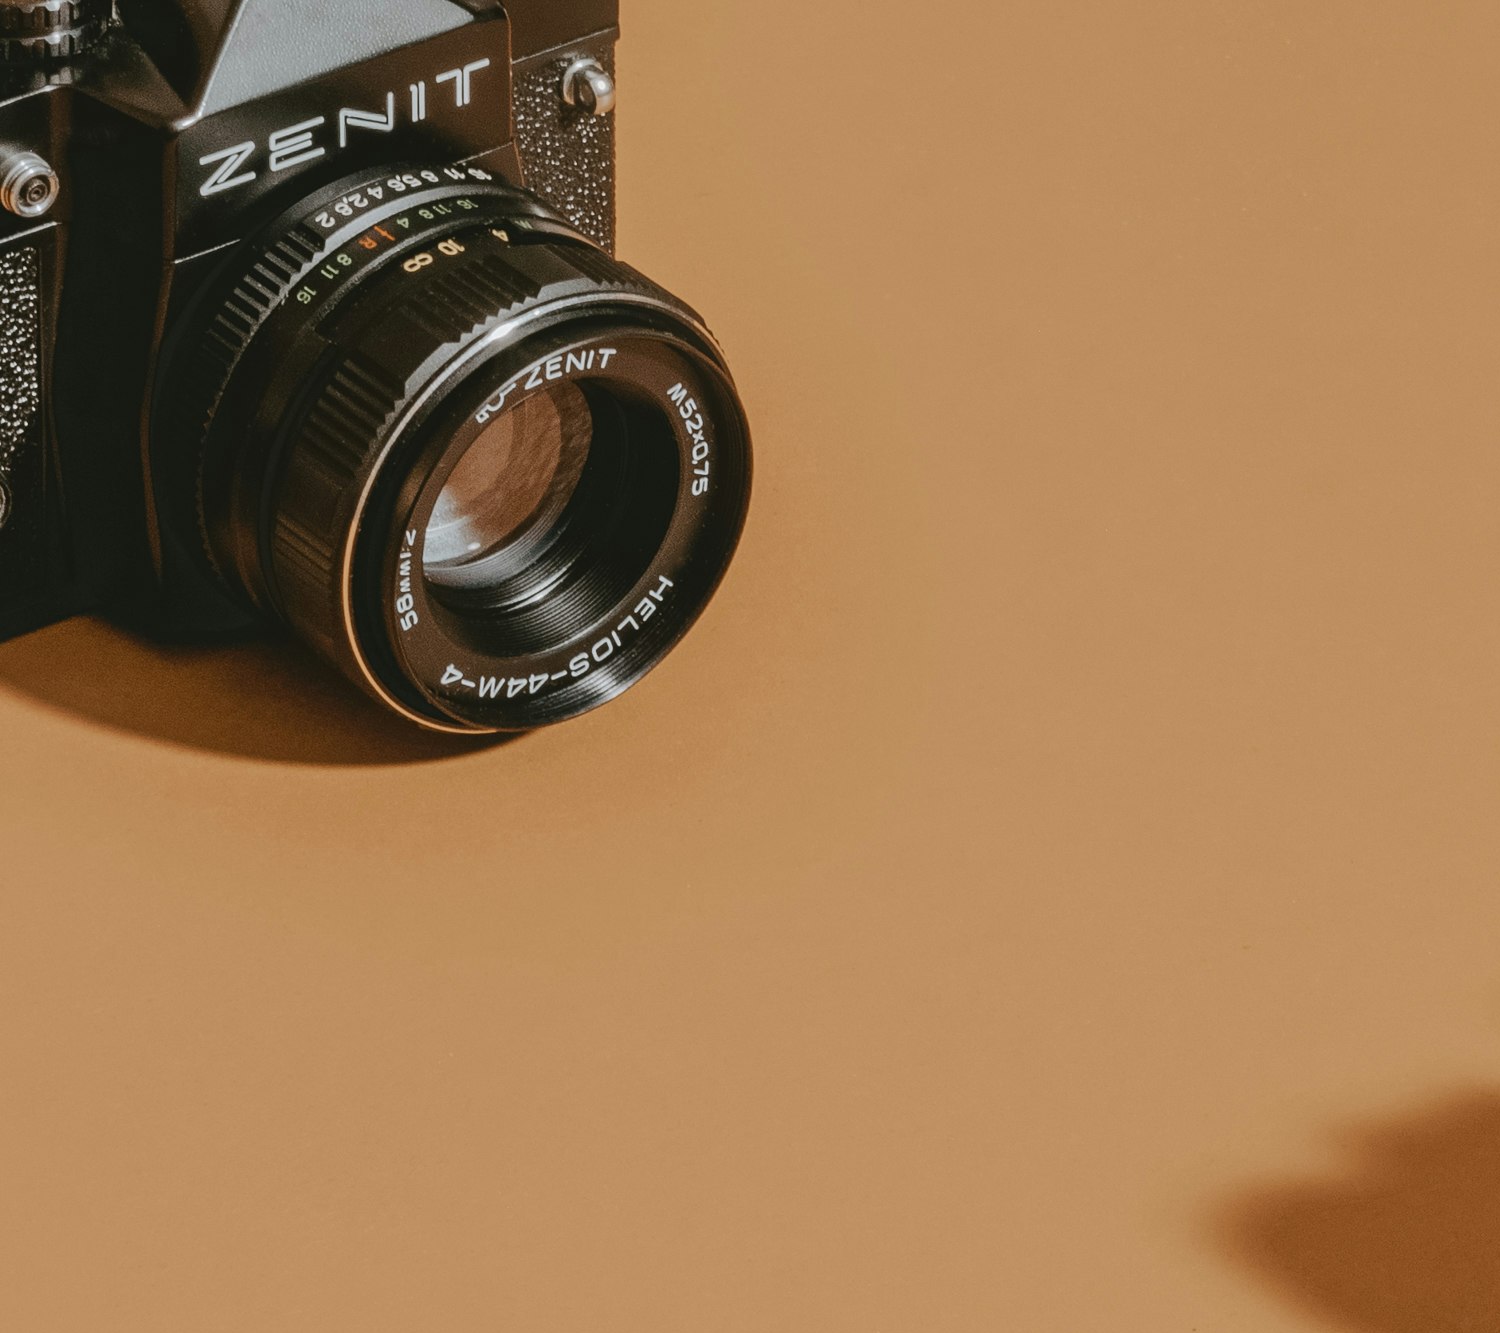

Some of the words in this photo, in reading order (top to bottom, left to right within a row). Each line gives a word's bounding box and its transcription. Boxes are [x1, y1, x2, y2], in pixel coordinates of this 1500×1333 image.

[198, 57, 490, 198] ZENIT
[387, 174, 422, 192] 5,6
[420, 170, 439, 183] 8
[366, 186, 383, 200] 4
[334, 193, 369, 217] 2,8
[314, 212, 336, 229] 2
[437, 238, 465, 256] 10
[524, 349, 617, 391] ZENIT
[666, 383, 709, 498] M52x0,75
[440, 575, 673, 699] HELIOS-44M-4
